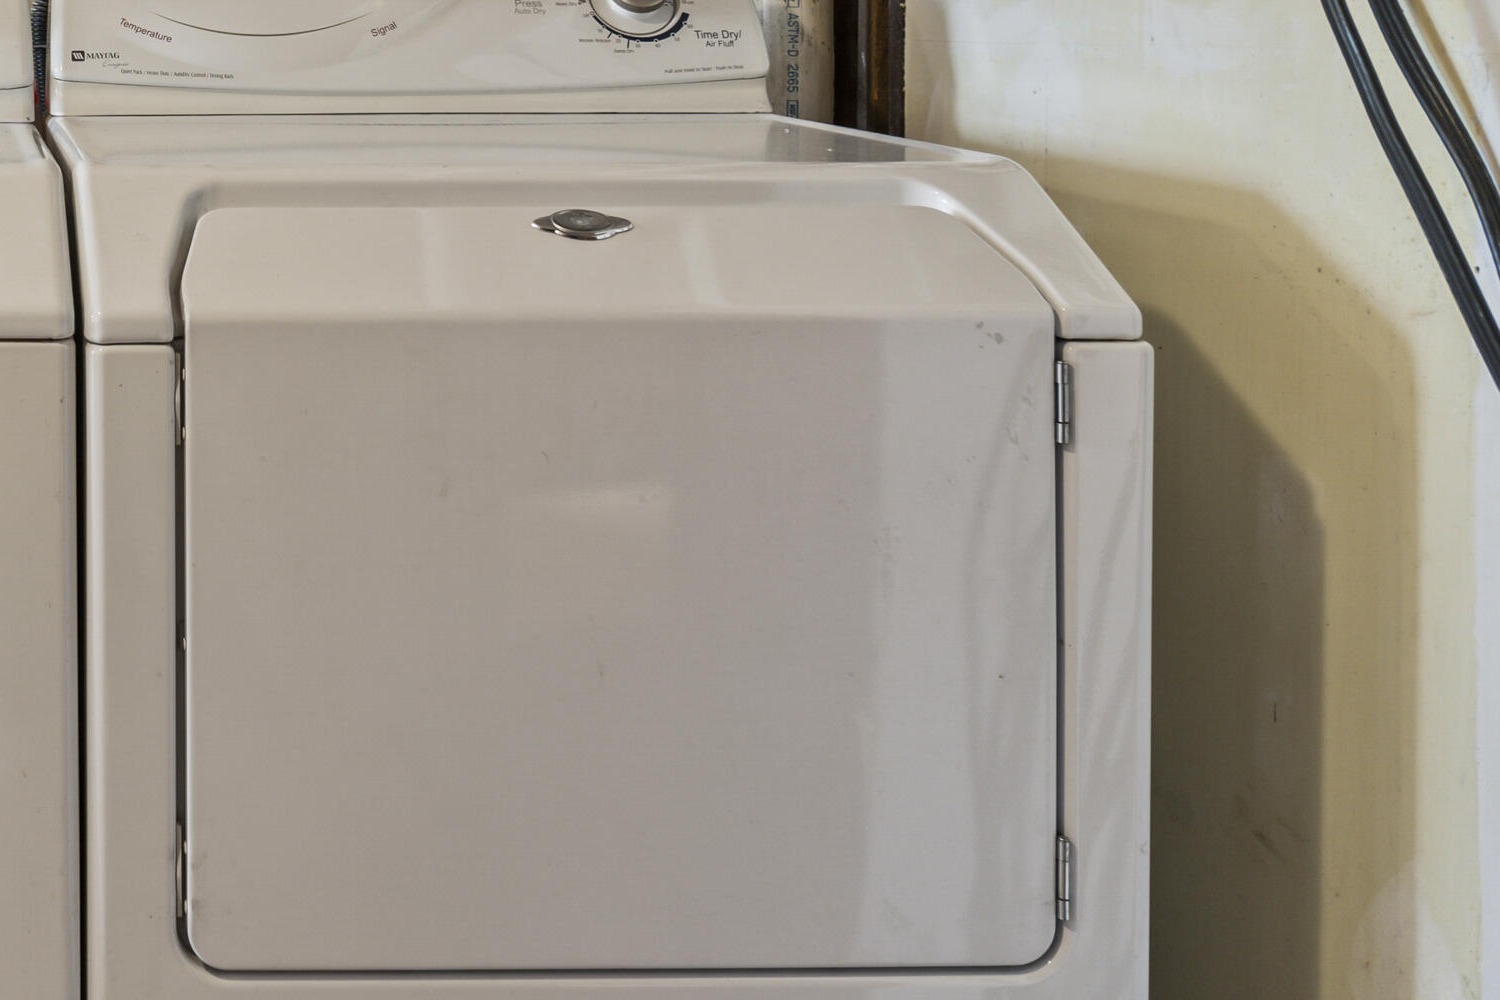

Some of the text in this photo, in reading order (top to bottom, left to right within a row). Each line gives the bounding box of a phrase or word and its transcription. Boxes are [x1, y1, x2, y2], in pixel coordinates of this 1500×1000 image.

[514, 0, 543, 8] Press
[531, 7, 546, 15] Dry
[120, 17, 174, 43] Temperature
[370, 21, 398, 37] Signal
[694, 30, 742, 41] Time Dry/
[787, 12, 801, 58] ASTM-D
[787, 63, 800, 94] 2665
